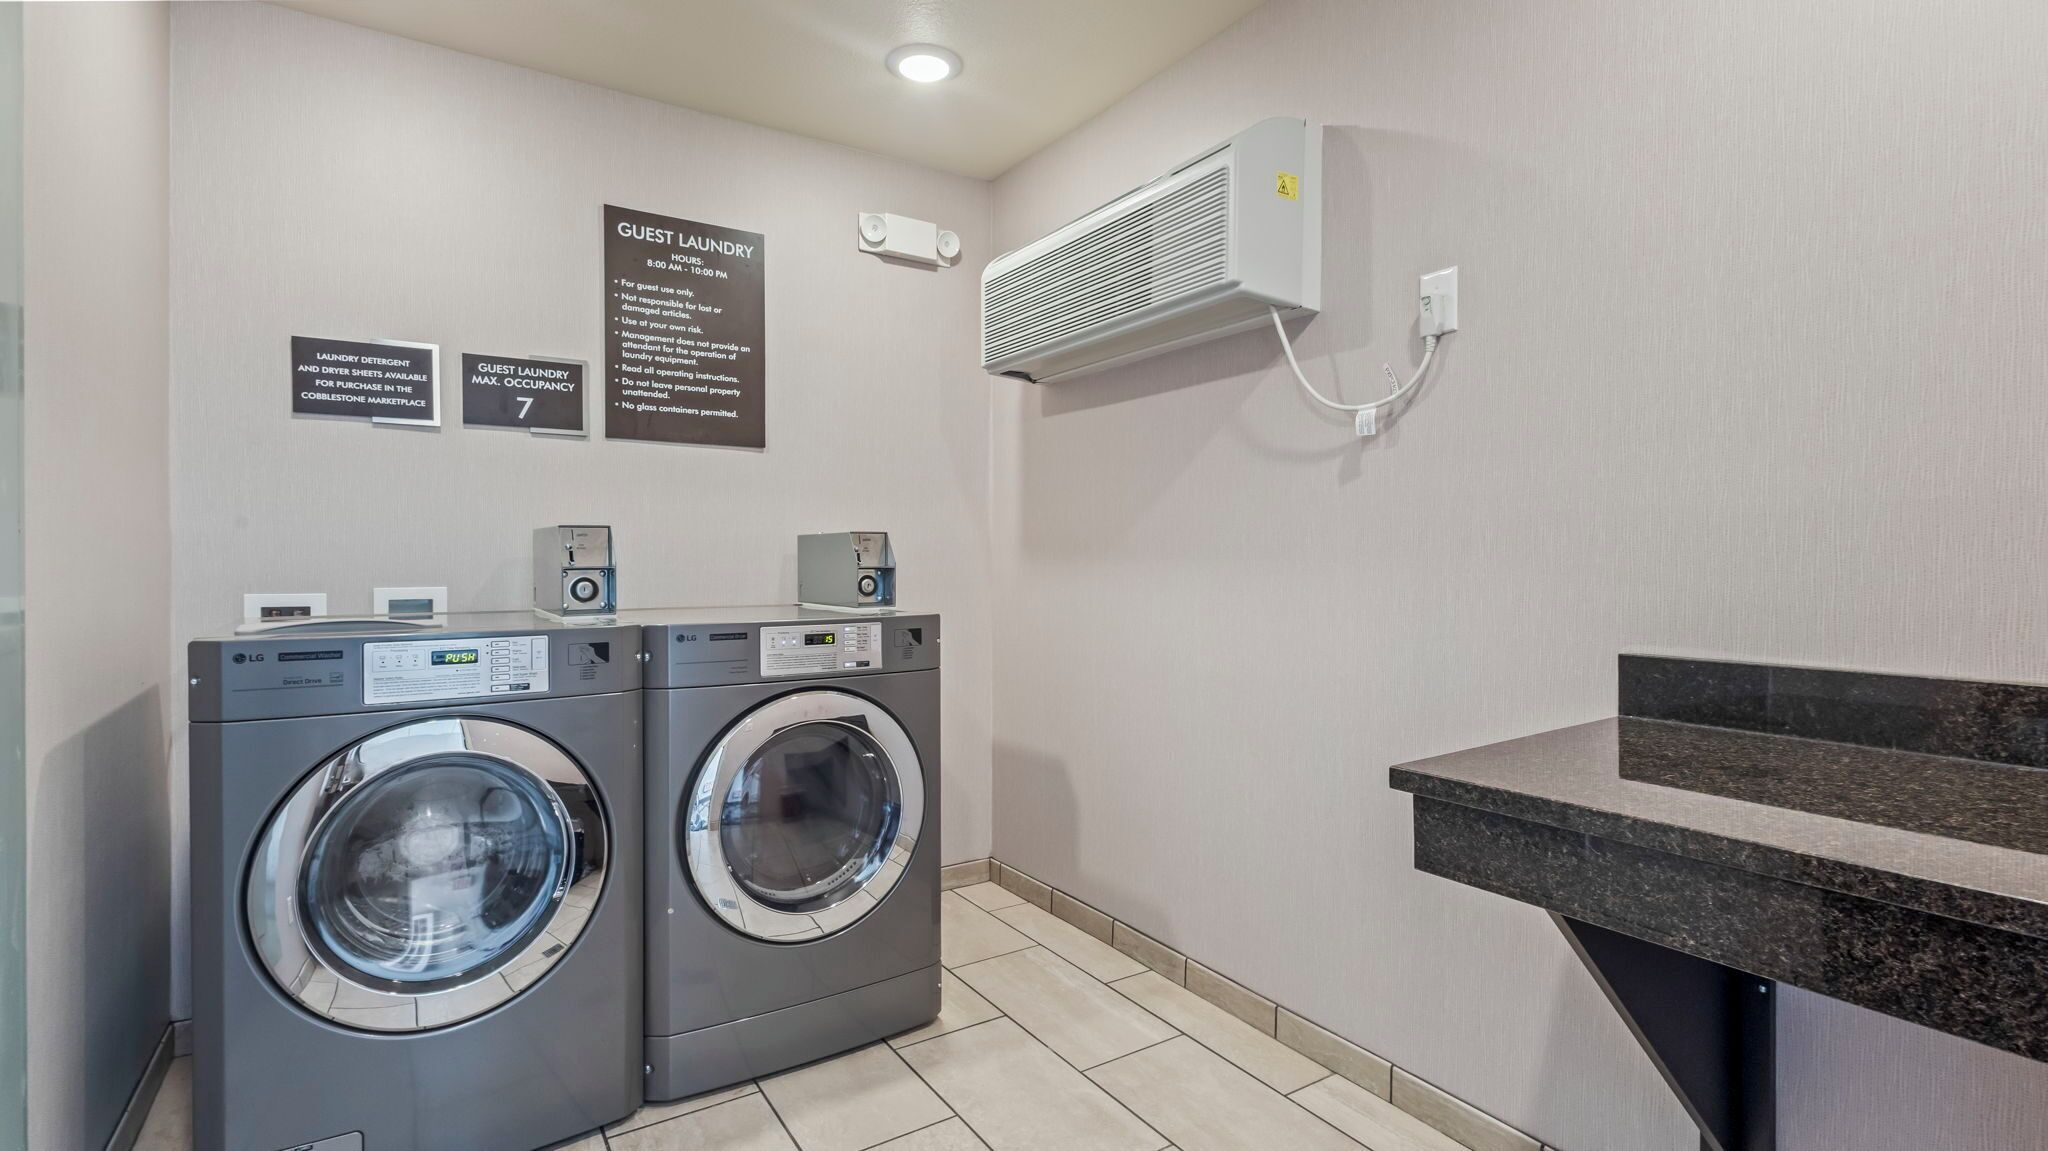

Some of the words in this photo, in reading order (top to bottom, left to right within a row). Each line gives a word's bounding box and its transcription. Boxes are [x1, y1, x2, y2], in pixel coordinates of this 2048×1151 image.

[618, 222, 674, 244] GUEST
[679, 233, 754, 258] LAUNDRY
[672, 254, 704, 266] HOURS:
[647, 260, 666, 269] 8:00
[668, 263, 682, 271] AM
[691, 266, 714, 276] 10:00
[716, 270, 728, 279] PM
[621, 279, 635, 287] For
[676, 289, 694, 297] only.
[621, 293, 637, 301] Not
[639, 297, 683, 308] responsible
[686, 302, 696, 310] for
[698, 304, 712, 312] lost
[622, 303, 659, 315] damaged
[662, 309, 691, 319] articles.
[621, 317, 637, 325] Use
[650, 321, 667, 329] your
[621, 331, 674, 343] Management
[677, 337, 695, 346] does
[697, 340, 709, 348] not
[711, 342, 738, 351] provide
[622, 342, 660, 351] attendant
[663, 345, 674, 353] for
[676, 347, 688, 355] the
[690, 349, 726, 359] operation
[622, 350, 653, 362] laundry
[655, 355, 698, 365] equipment.
[317, 353, 359, 363] LAUNDRY
[361, 356, 410, 367] DETERGENT
[298, 364, 319, 373] AND
[322, 367, 350, 375] DRYER
[352, 369, 383, 378] SHEETS
[384, 372, 427, 381] AVAILABLE
[478, 363, 515, 374] GUEST
[518, 367, 569, 379] LAUNDRY
[622, 364, 642, 373] Read
[656, 369, 694, 379] operating
[696, 371, 740, 383] instructions.
[315, 379, 335, 387] FOR
[337, 381, 382, 391] PURCHASE
[396, 385, 413, 393] THE
[472, 375, 501, 386] MAX.
[504, 378, 575, 392] OCCUPANCY
[652, 380, 672, 389] leave
[675, 384, 708, 393] personal
[710, 387, 741, 397] property
[301, 392, 365, 402] COBBLESTONE
[368, 397, 426, 407] MARKETPLACE
[622, 388, 670, 399] unattended.
[517, 397, 534, 419] 7
[636, 403, 657, 411] glass
[659, 405, 699, 415] containers
[701, 408, 738, 418] permitted.
[249, 654, 264, 662] LG
[446, 653, 476, 663] PUSH
